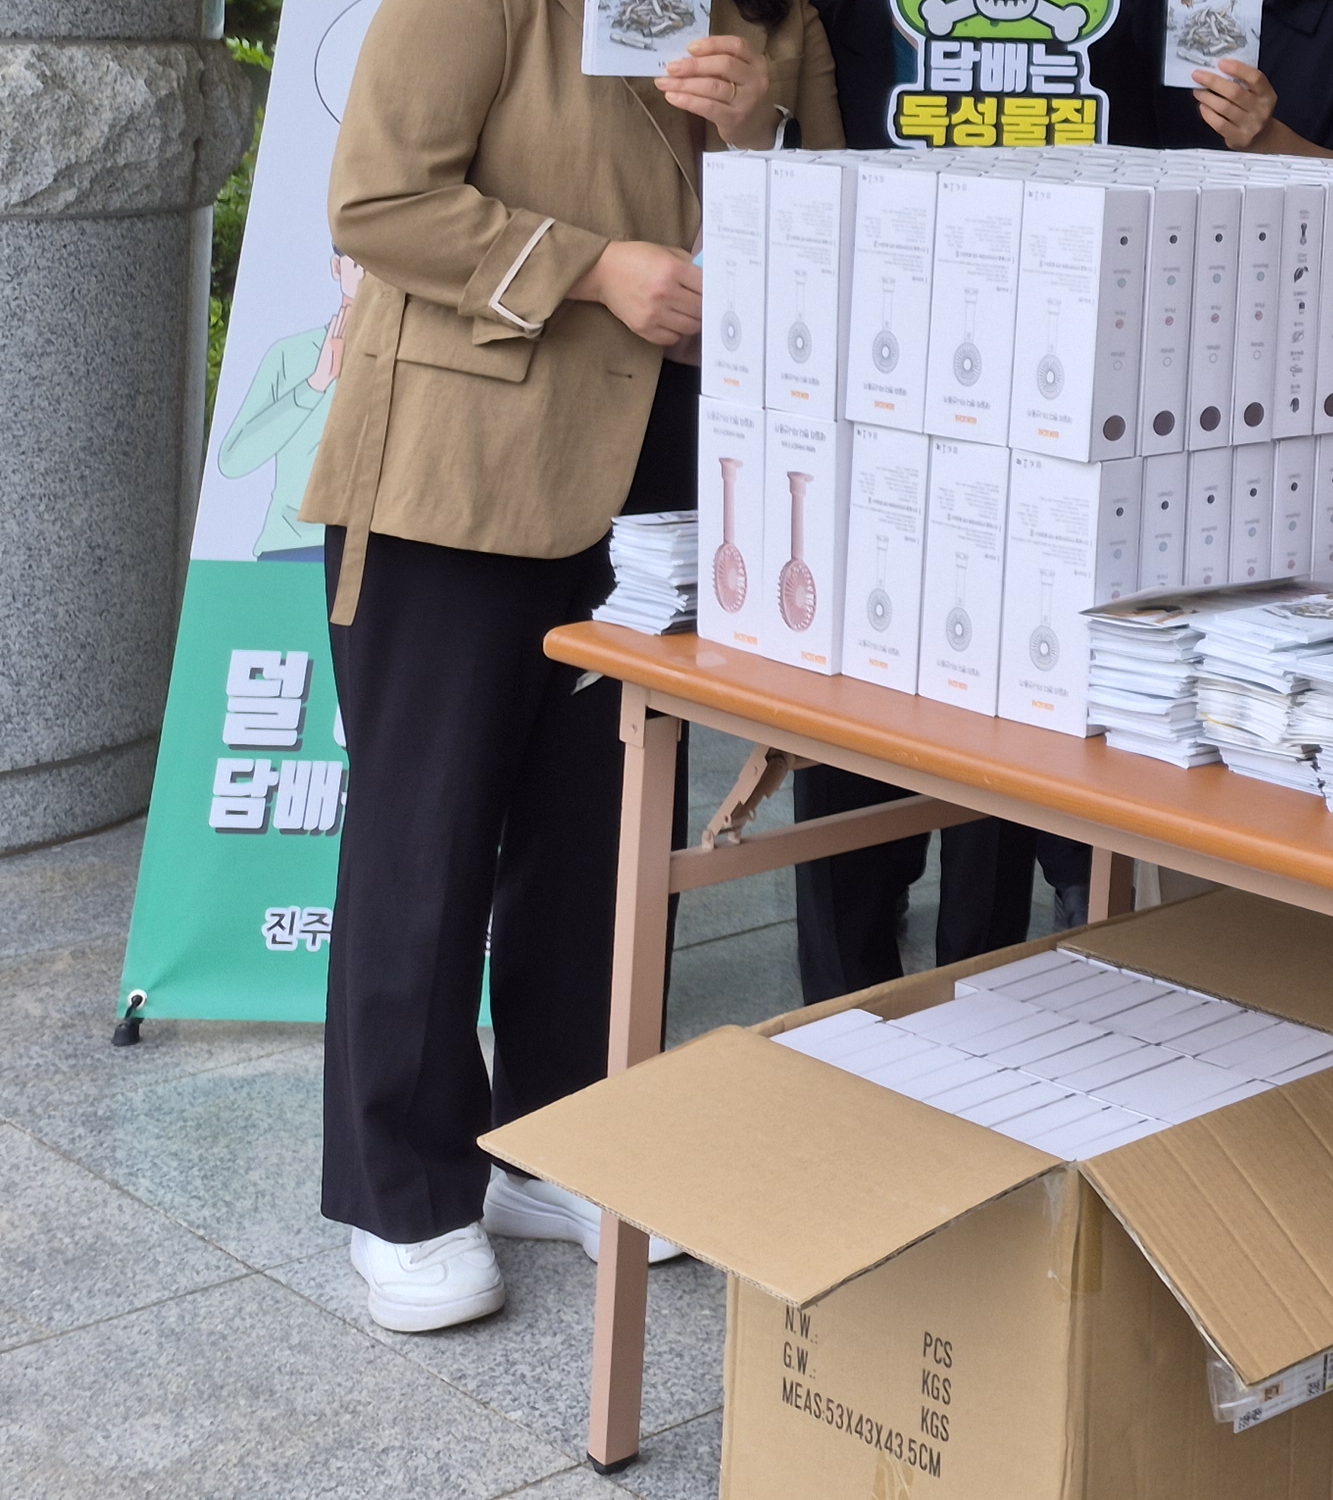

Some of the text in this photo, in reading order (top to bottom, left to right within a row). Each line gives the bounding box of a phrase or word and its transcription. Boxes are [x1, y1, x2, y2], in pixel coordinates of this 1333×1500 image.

[929, 41, 1079, 94] 담배는
[899, 95, 1097, 147] 독성물질
[222, 649, 314, 751] 덜
[923, 1330, 953, 1368] PCS
[921, 1368, 952, 1406] KGS
[920, 1405, 950, 1443] KGS
